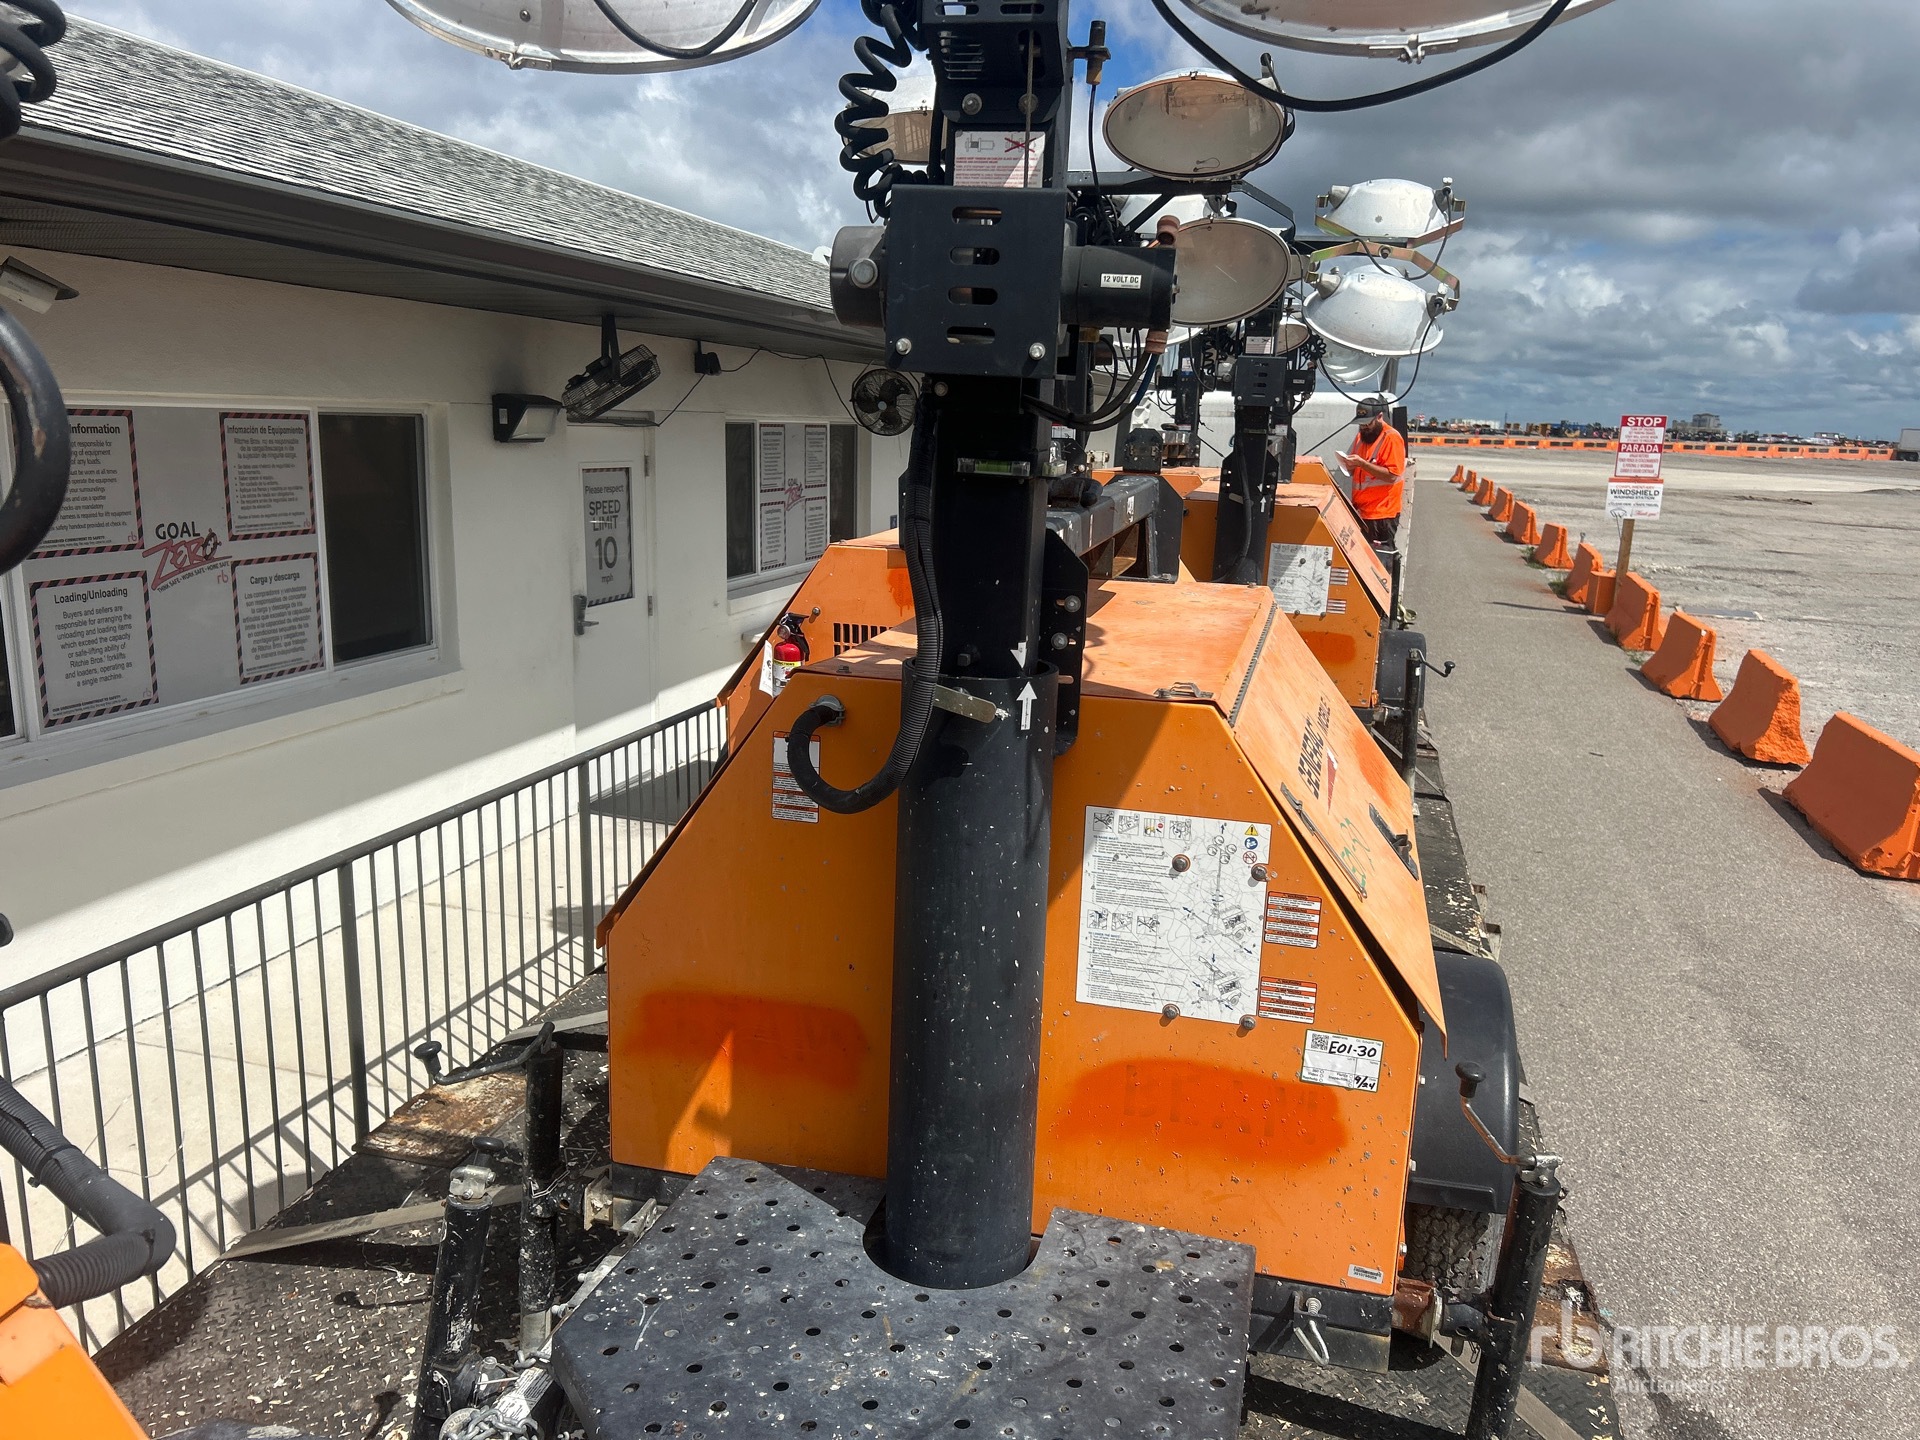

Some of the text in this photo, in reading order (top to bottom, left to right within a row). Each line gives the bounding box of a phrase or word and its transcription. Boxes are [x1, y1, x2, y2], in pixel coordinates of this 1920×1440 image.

[1103, 275, 1139, 284] 12 VOLT DC
[1627, 416, 1662, 427] STOP
[260, 425, 266, 434] de
[85, 449, 111, 457] equipment
[1621, 444, 1659, 453] PARADA
[585, 484, 624, 496] Please respect
[1610, 488, 1660, 497] WINDSHIELD
[589, 499, 621, 516] SPEED
[592, 514, 618, 531] LIMIT
[155, 521, 201, 540] GOAL
[142, 527, 232, 591] ZERO
[595, 536, 618, 570] 10
[169, 577, 181, 587] SAFE
[194, 567, 206, 575] SAFE
[217, 569, 229, 584] rb
[250, 575, 268, 585] Carga
[274, 572, 300, 581] descarga
[601, 573, 614, 584] mph
[54, 587, 128, 604] Loading/Unloading
[63, 611, 83, 619] Buyers
[84, 608, 95, 616] and
[95, 606, 113, 614] sellers
[55, 619, 87, 630] responsible
[88, 617, 96, 625] for
[97, 615, 123, 625] arranging
[57, 622, 132, 640] unloading and loading items
[60, 632, 131, 650] which exceed the capacity
[65, 671, 76, 679] and
[100, 662, 125, 673] operating
[70, 659, 89, 668] Ritchie
[82, 677, 98, 686] single
[99, 672, 123, 681] machine.
[1298, 716, 1324, 800] GENERAC
[1328, 1041, 1377, 1058] E01-30
